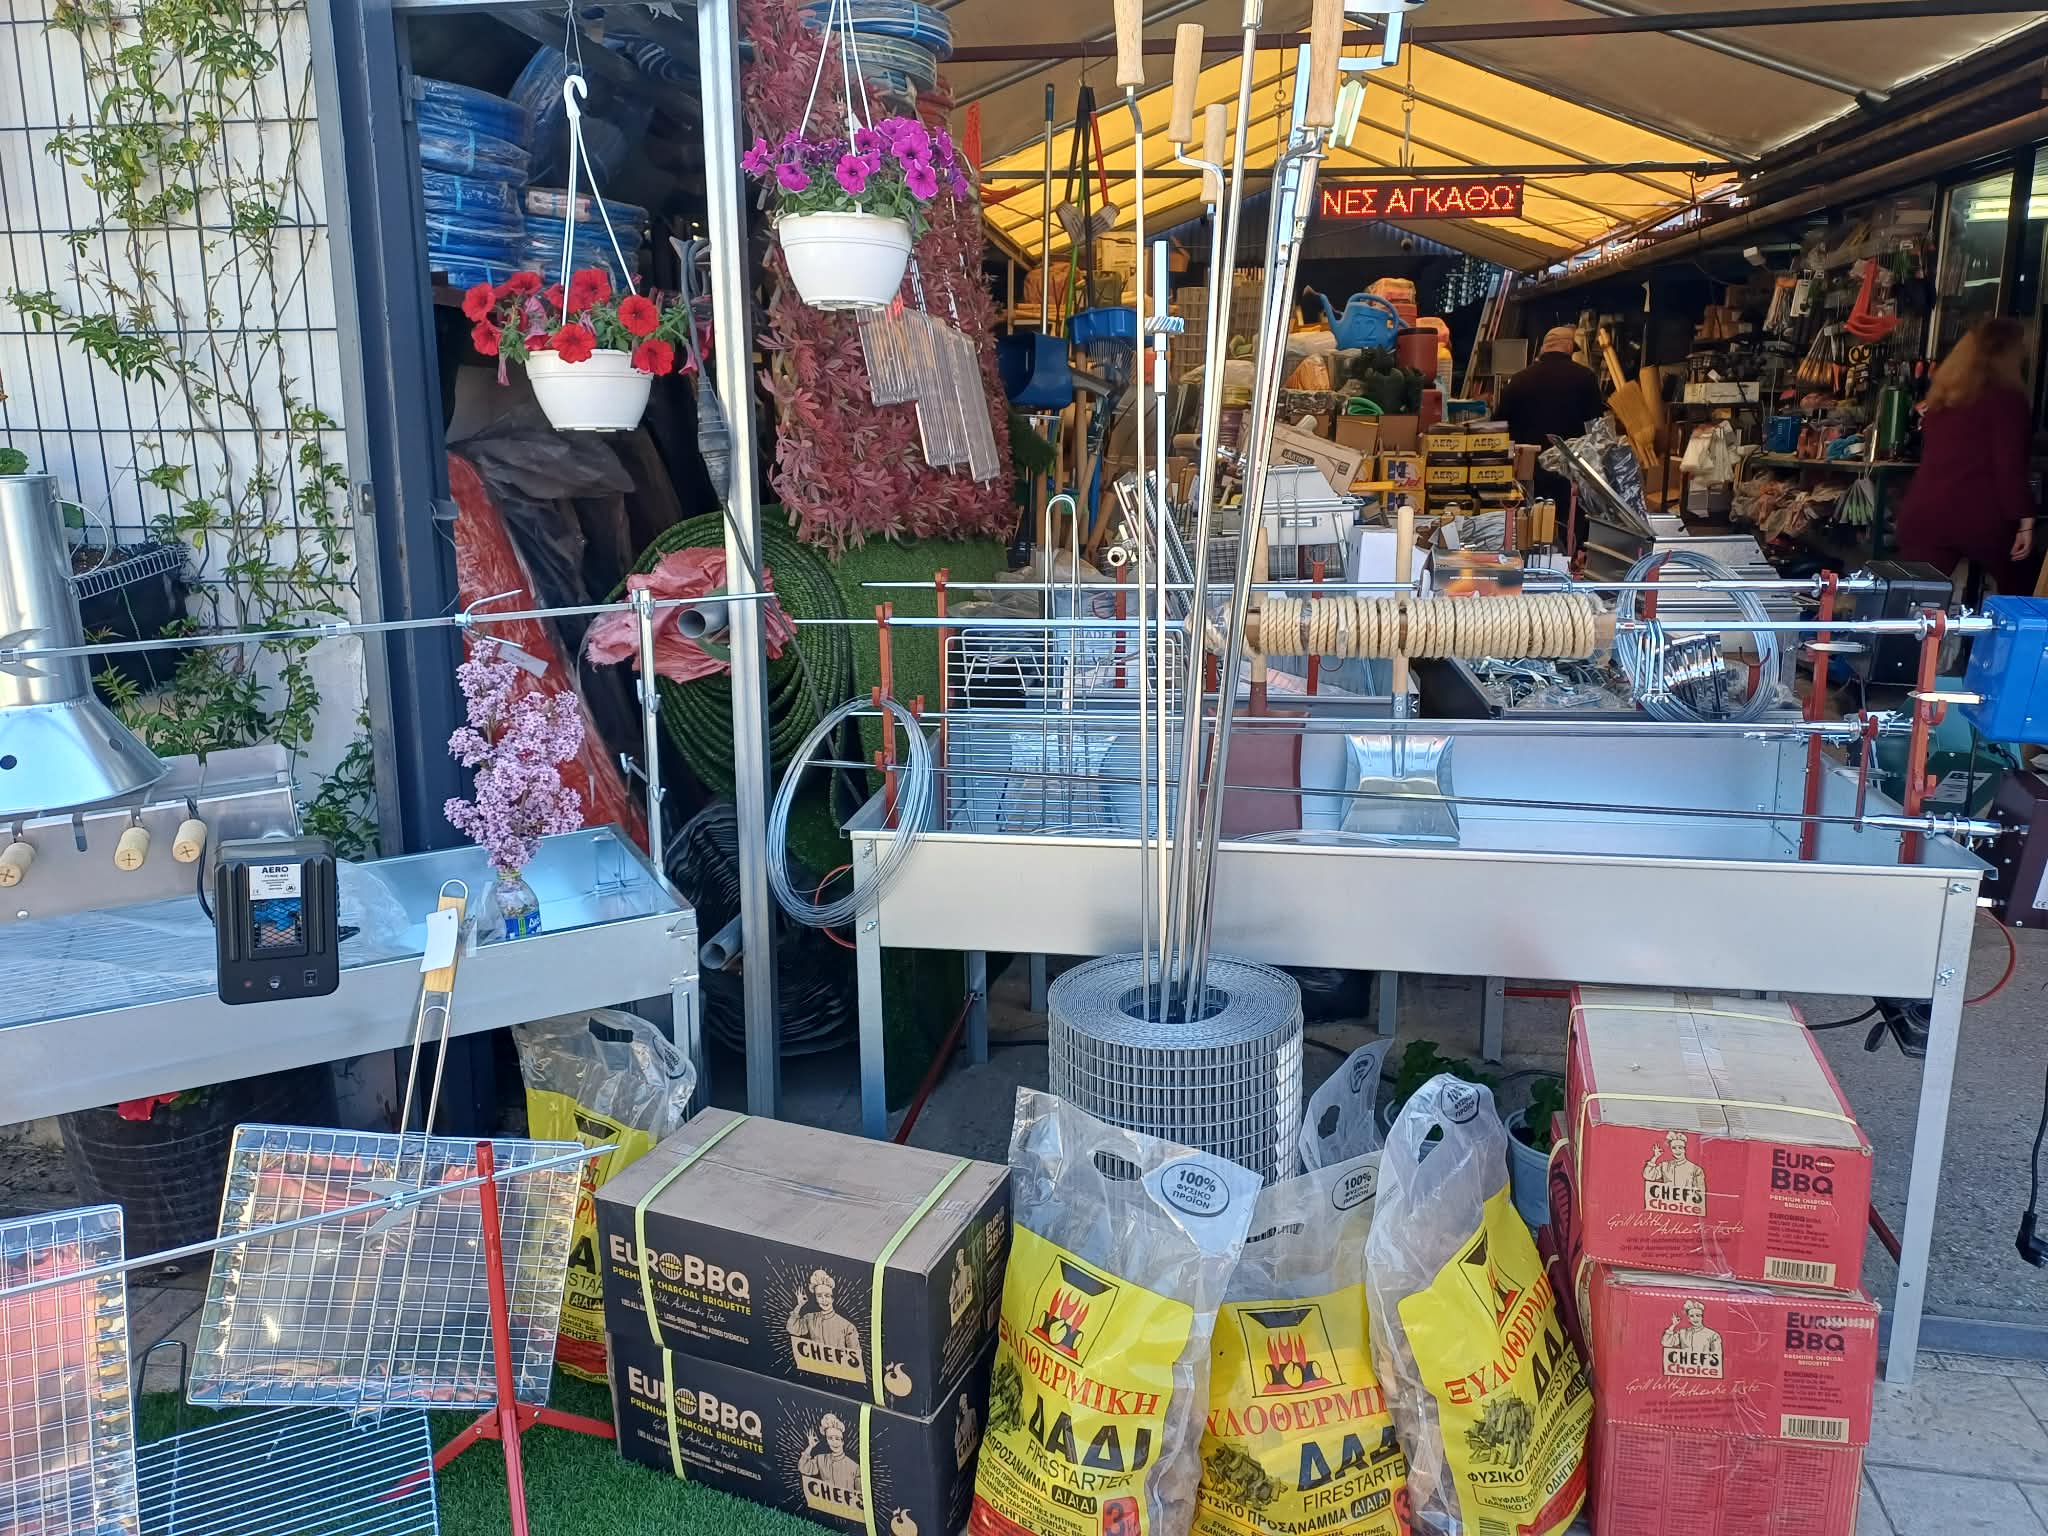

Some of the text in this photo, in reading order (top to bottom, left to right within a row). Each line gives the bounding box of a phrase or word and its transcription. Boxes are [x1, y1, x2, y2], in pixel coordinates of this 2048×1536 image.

[1323, 184, 1521, 215] ΝΕΣ ΑΓΚΑΘΩ
[261, 866, 289, 874] AERO
[1177, 1183, 1212, 1201] ΦΥΣΙΚΟ
[1179, 1169, 1216, 1193] 100%
[1345, 1171, 1372, 1190] 100%
[1650, 1184, 1703, 1204] CHEF'S
[1771, 1168, 1833, 1194] BBQ
[1649, 1199, 1702, 1214] Choice
[612, 1266, 655, 1287] PREMIM
[657, 1280, 700, 1300] CHARCOAL
[702, 1295, 752, 1316] BRIQUETTE
[706, 1308, 727, 1323] Taste
[1445, 1270, 1553, 1404] ΞΥΛΟΘΕΡΜΙ
[1786, 1330, 1845, 1351] BBQ
[797, 1341, 860, 1368] CHEF'S
[1667, 1351, 1719, 1367] CHEF'S
[1667, 1363, 1718, 1376] Choice
[1540, 1352, 1578, 1418] FIRESTAR
[628, 1366, 762, 1438] EUOBBQ
[1207, 1384, 1388, 1437] ΥΛΟΘΕΡΜΙ
[716, 1431, 764, 1454] BRIQUETTE
[1029, 1394, 1152, 1472] ΔΑΔΙ
[1468, 1470, 1525, 1484] ΦΥΣΙΚΟ
[1524, 1401, 1565, 1473] ΠΡΟΣΑΝΑΜΜΑ
[1025, 1439, 1134, 1491] FIRESTARTER
[1297, 1426, 1400, 1491] ΔΑΔ
[1545, 1451, 1580, 1495] ΟΔΗΓΙΕΣ
[808, 1481, 864, 1511] CHEF'S
[991, 1498, 1035, 1531] ΟΔΗΓΙΕΣ
[1247, 1510, 1348, 1536] ΠΡΟΣΑΝΑΜΜΑ
